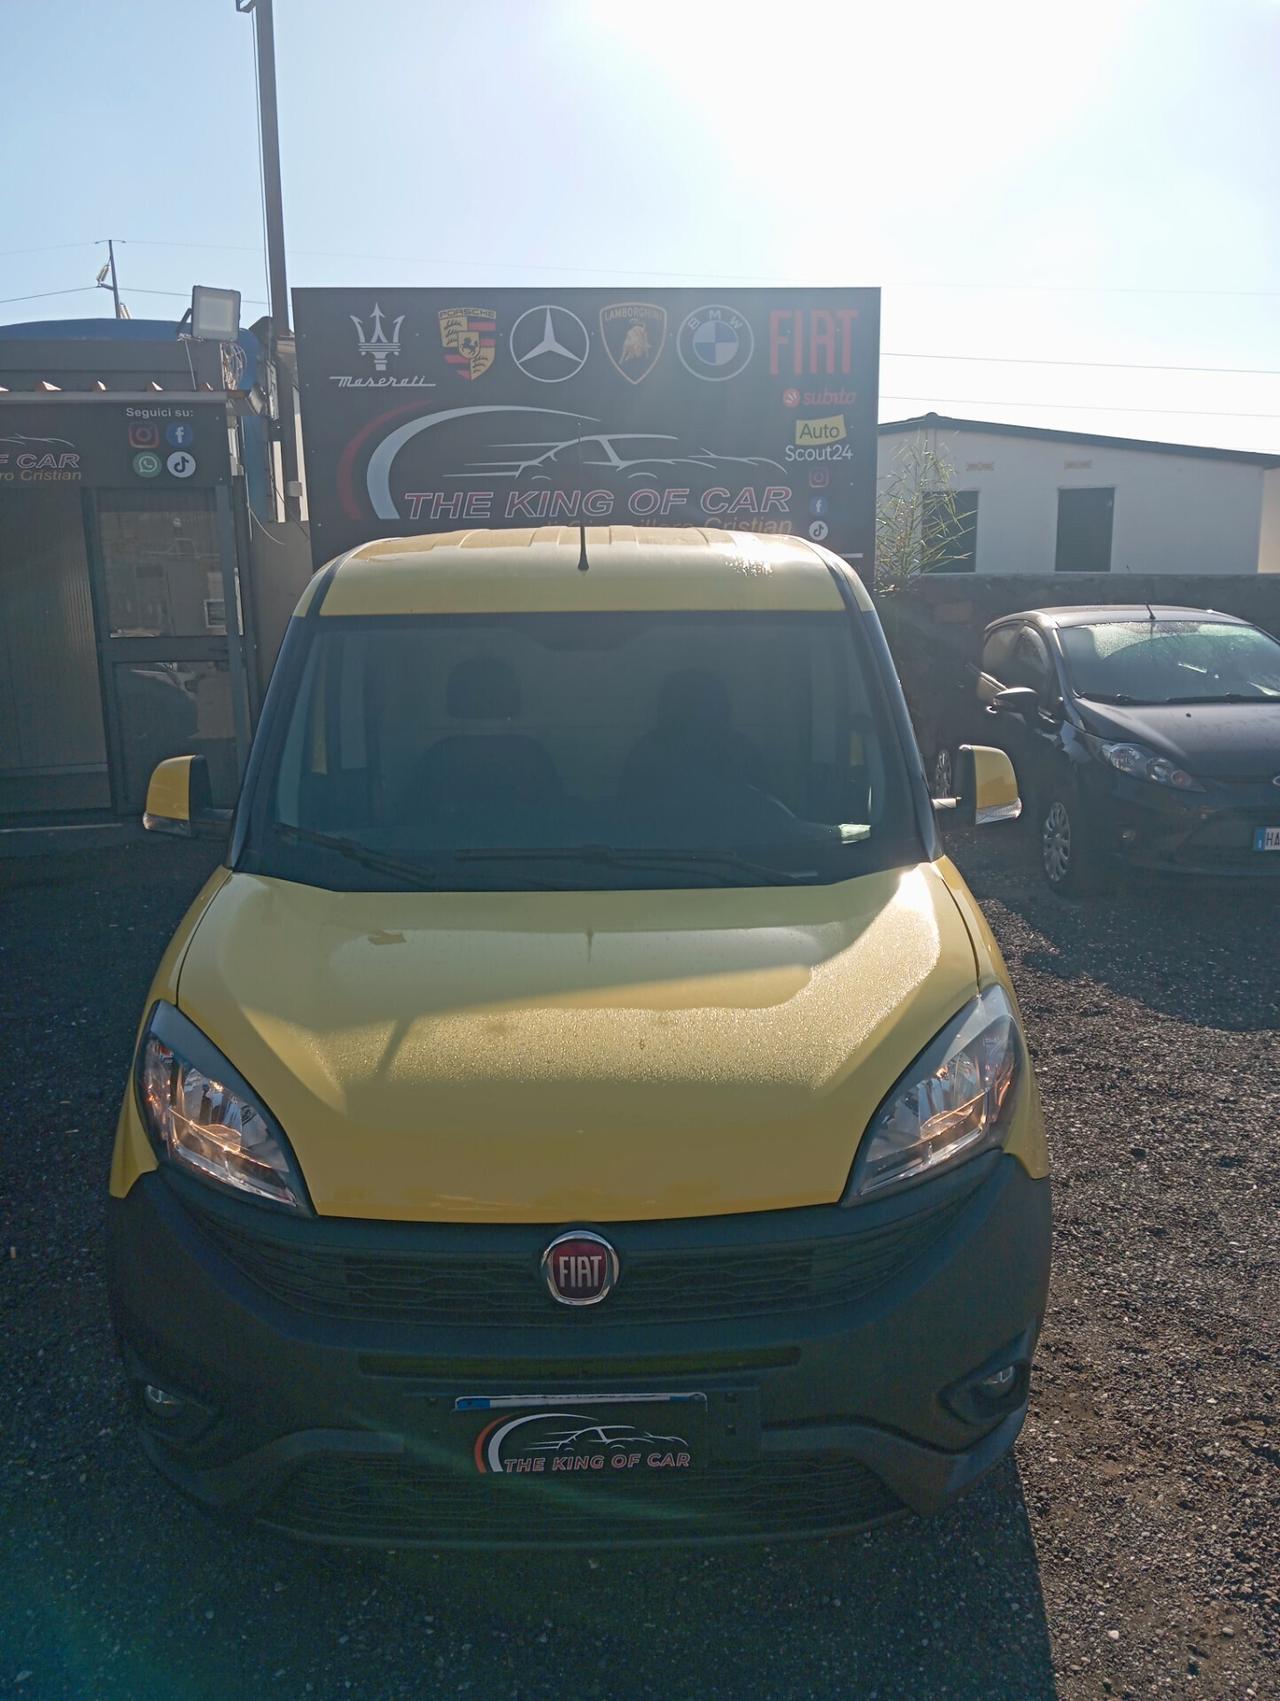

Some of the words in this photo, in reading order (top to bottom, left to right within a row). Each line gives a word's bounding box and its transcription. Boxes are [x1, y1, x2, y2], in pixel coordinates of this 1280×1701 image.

[770, 309, 858, 376] FIAT
[803, 386, 856, 405] subito
[126, 407, 171, 419] Seguici
[175, 408, 194, 418] su:
[800, 423, 840, 439] Auto
[16, 453, 80, 469] CAR
[785, 444, 853, 461] Scout24
[20, 469, 81, 481] Cristian
[404, 491, 494, 519] THE
[504, 489, 615, 518] KING
[628, 488, 690, 515] OF
[700, 486, 792, 513] CAR
[559, 1256, 602, 1287] FIAT
[504, 1457, 545, 1473] THE
[552, 1455, 604, 1471] KING
[611, 1453, 641, 1469] OF
[646, 1452, 690, 1468] CAR
